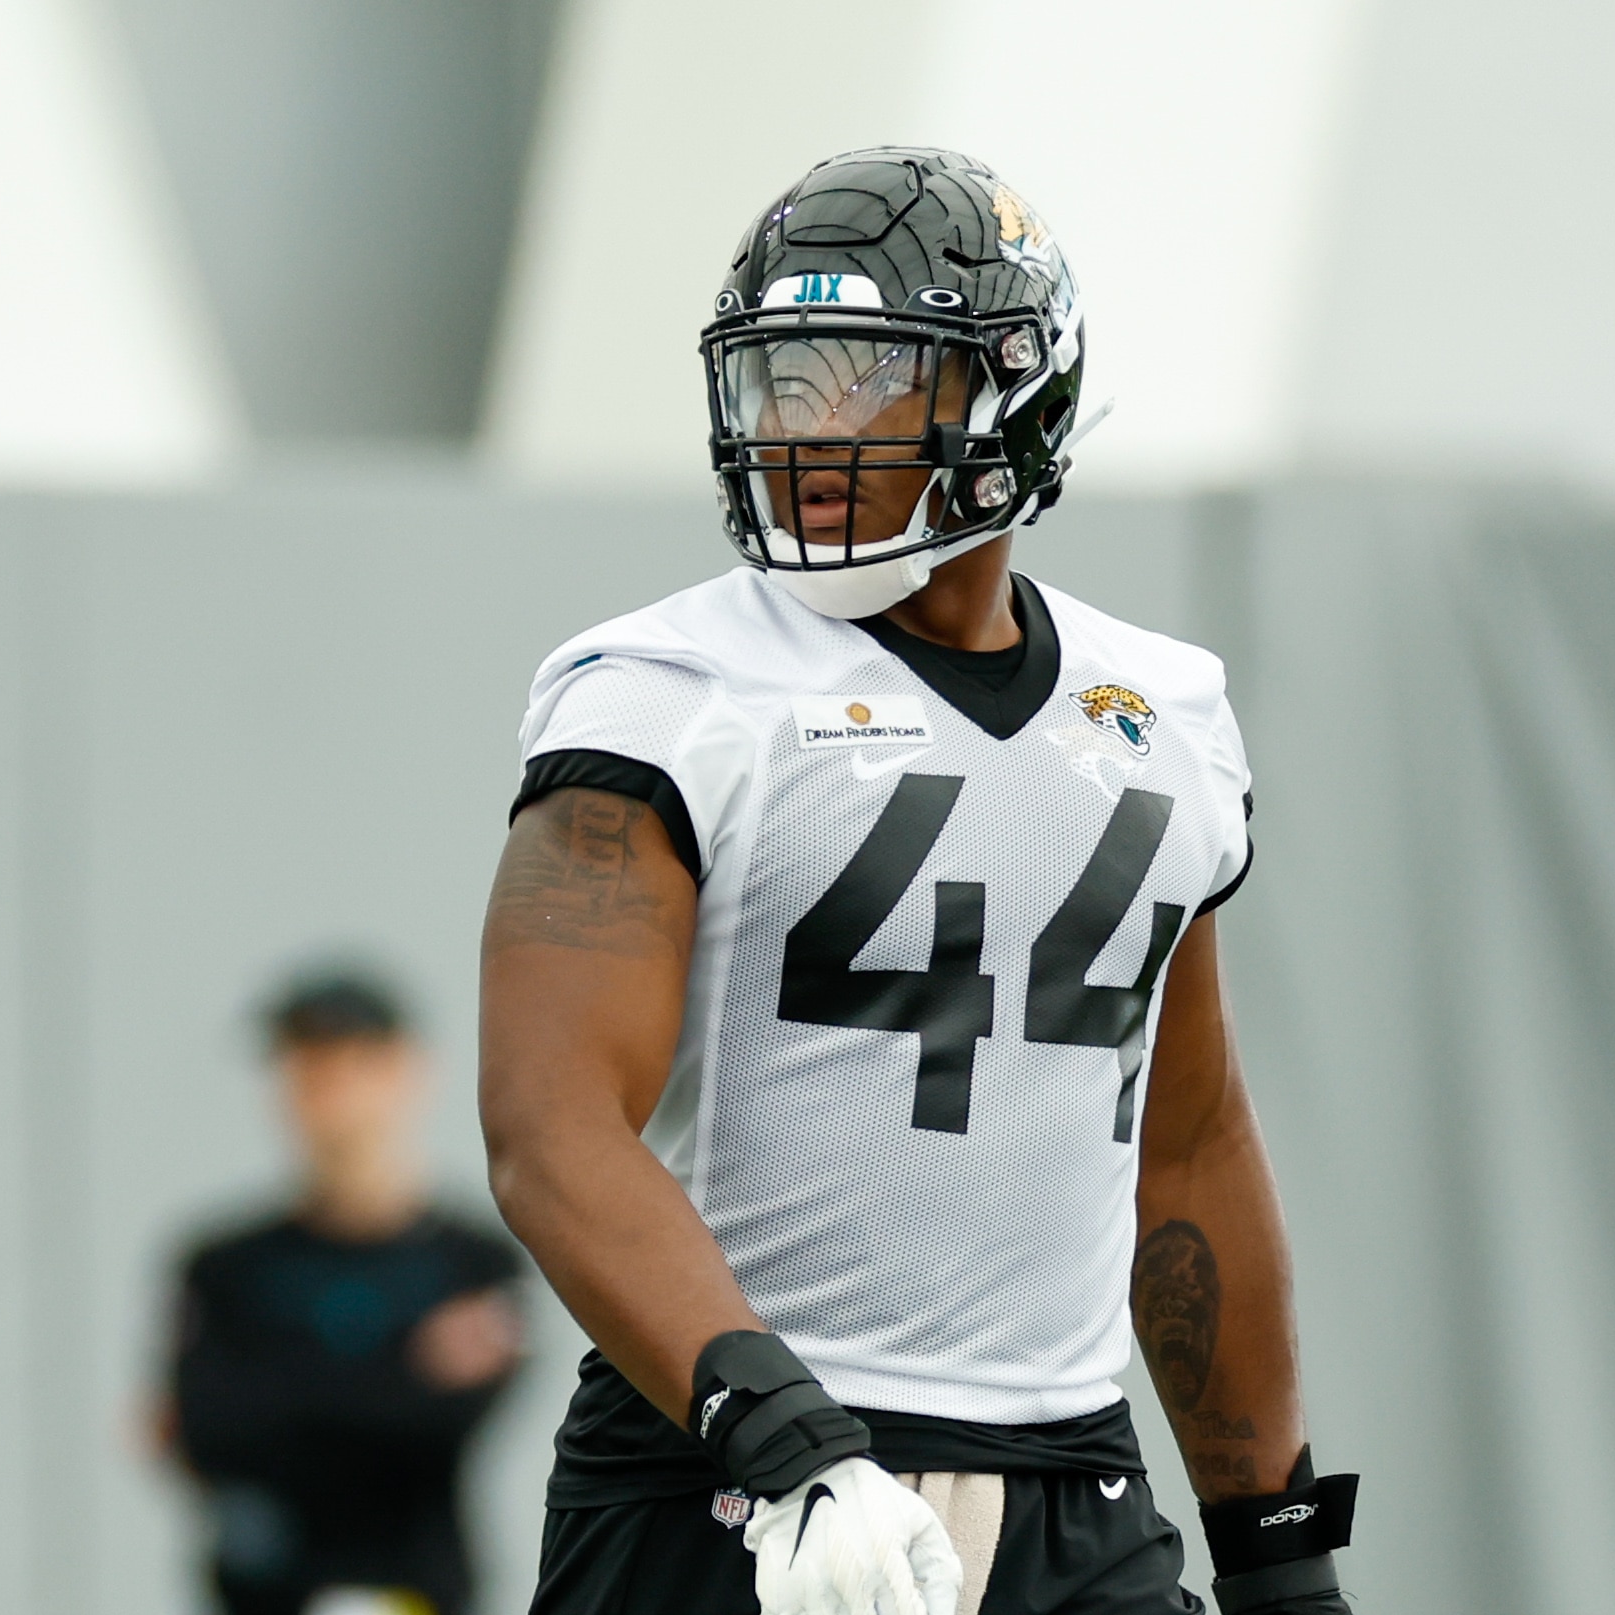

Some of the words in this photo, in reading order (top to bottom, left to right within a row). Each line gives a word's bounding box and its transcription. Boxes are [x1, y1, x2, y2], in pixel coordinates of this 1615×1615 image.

[794, 273, 843, 303] JAX
[805, 729, 844, 741] DREAM
[846, 727, 888, 738] FINDERS
[889, 726, 926, 737] HOMES
[777, 773, 1185, 1144] 44
[717, 1495, 746, 1520] NFL
[1260, 1504, 1316, 1527] DONJOY
